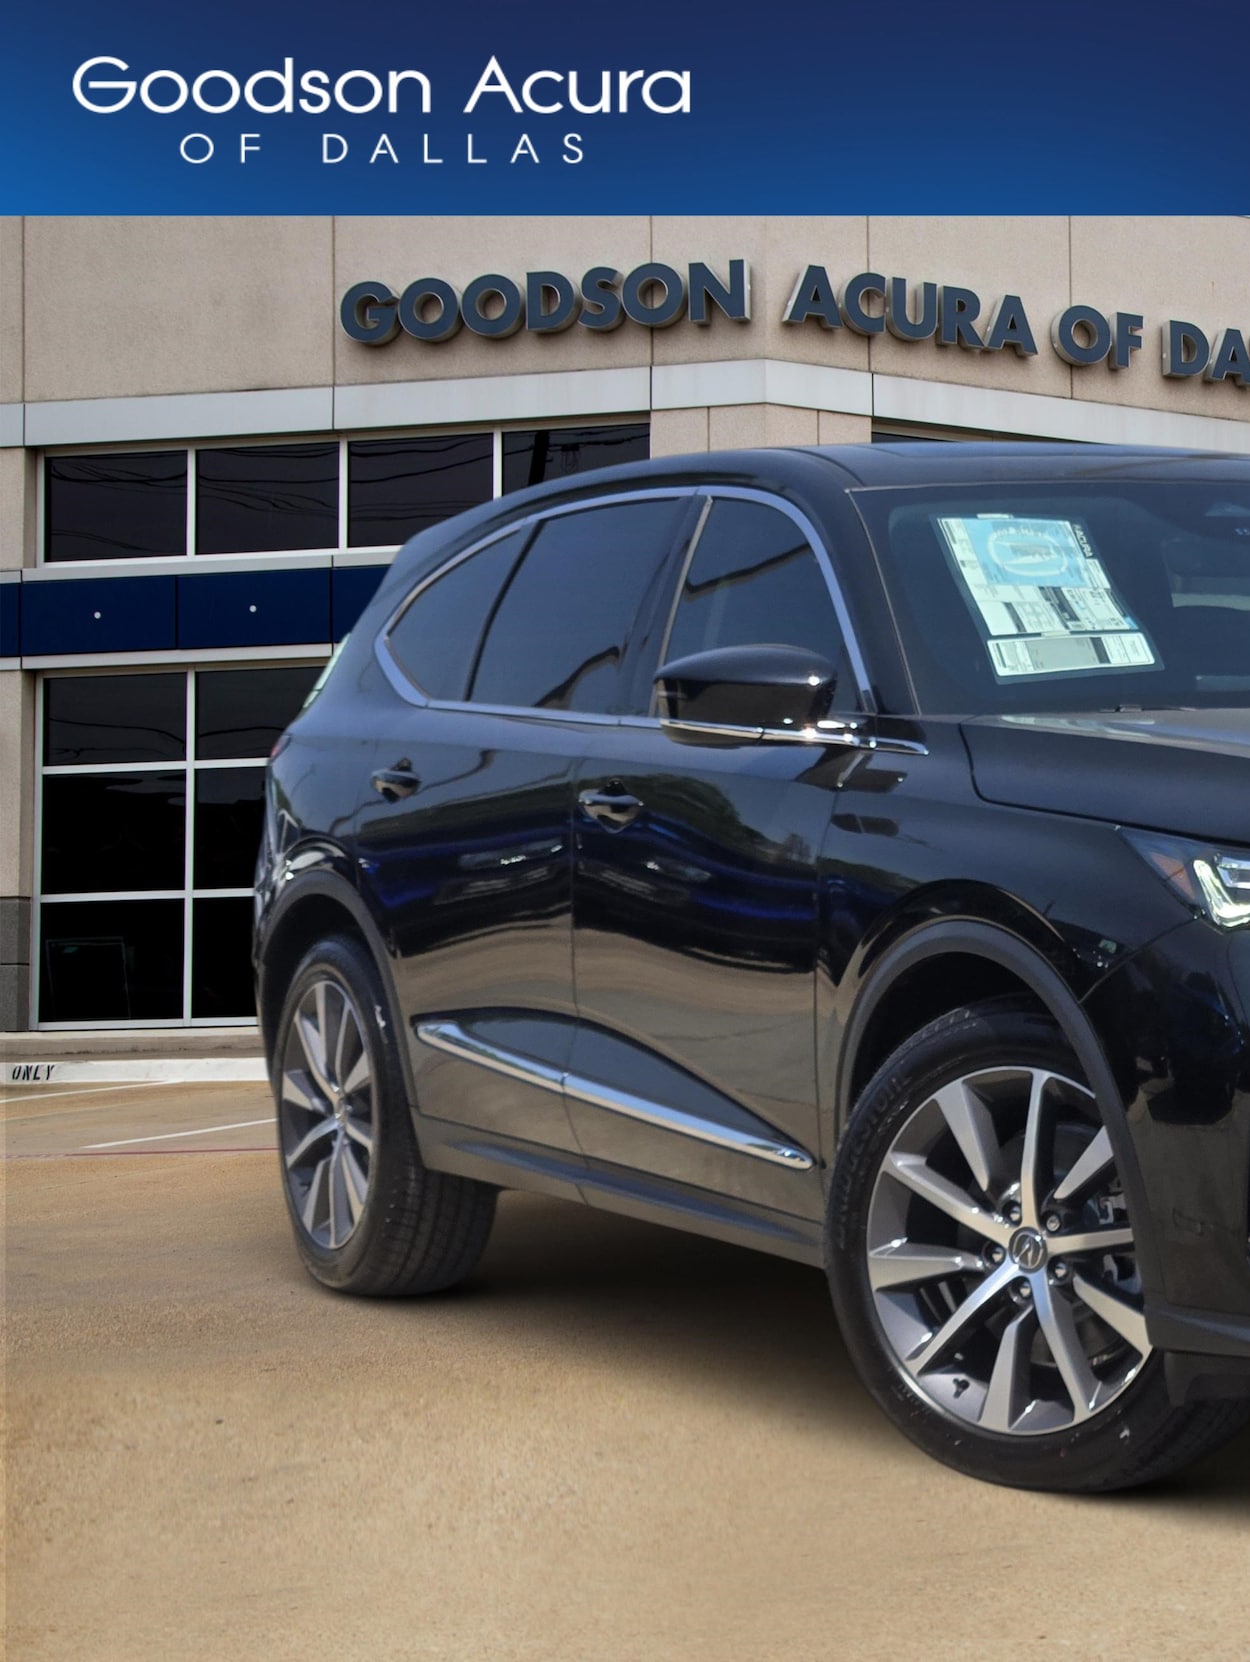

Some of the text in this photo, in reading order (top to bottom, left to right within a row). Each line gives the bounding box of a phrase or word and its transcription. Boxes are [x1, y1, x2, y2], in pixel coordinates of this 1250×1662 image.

[340, 259, 750, 345] GOODSON
[784, 265, 1038, 357] ACURA
[1051, 304, 1144, 370] OF
[12, 1064, 55, 1080] ONLY
